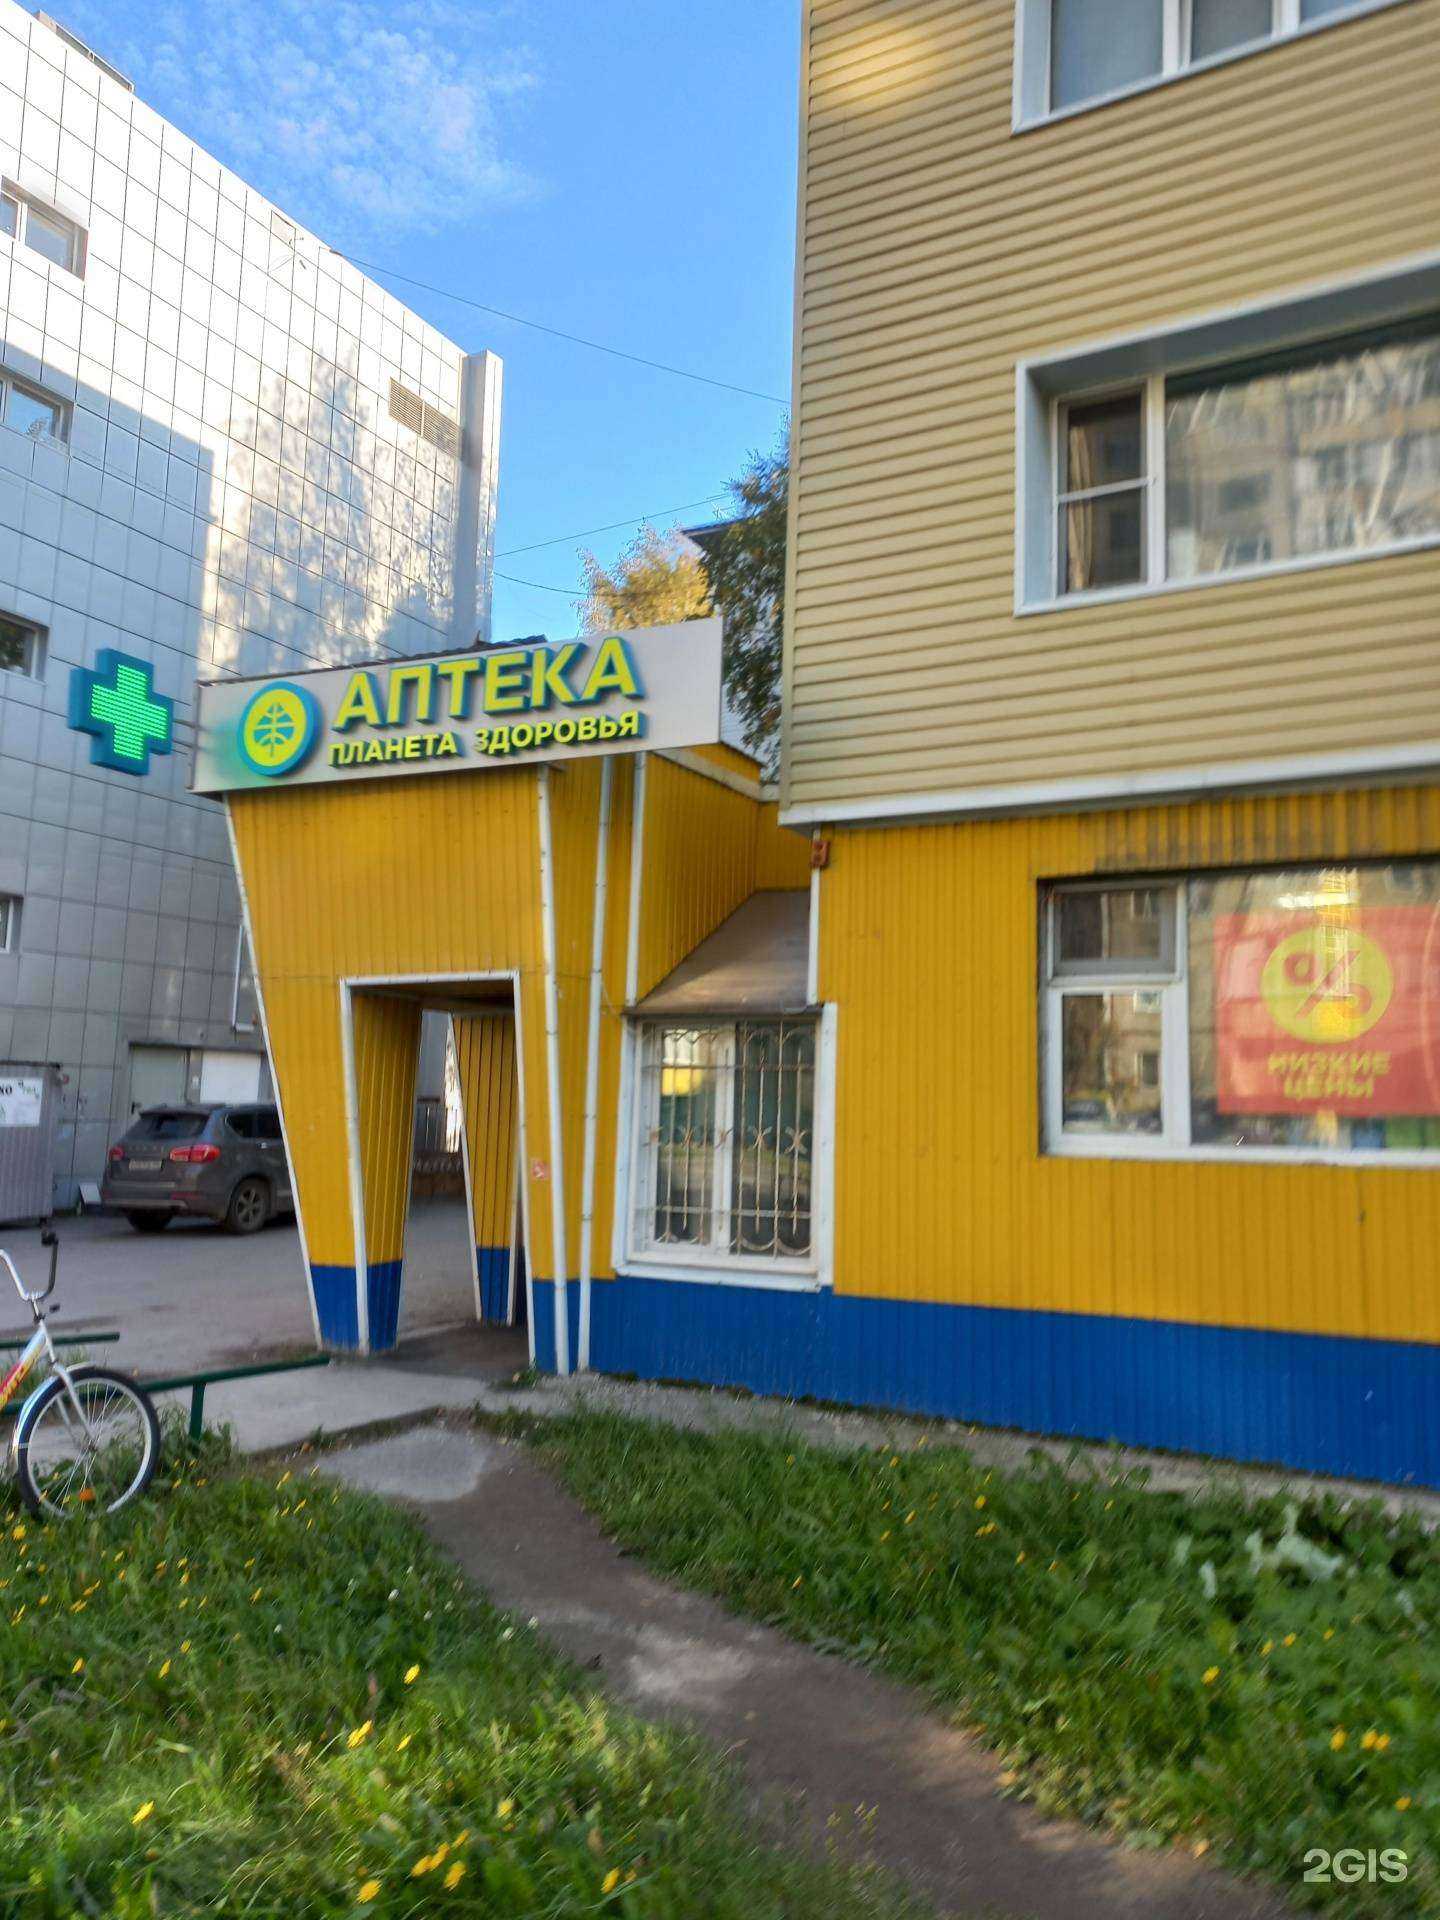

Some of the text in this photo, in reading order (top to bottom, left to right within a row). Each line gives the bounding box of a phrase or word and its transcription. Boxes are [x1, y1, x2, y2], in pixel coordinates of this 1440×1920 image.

[333, 637, 643, 731] АПТЕКА
[328, 709, 645, 767] ПЛАНЕТА ЗДОРОВЬЯ
